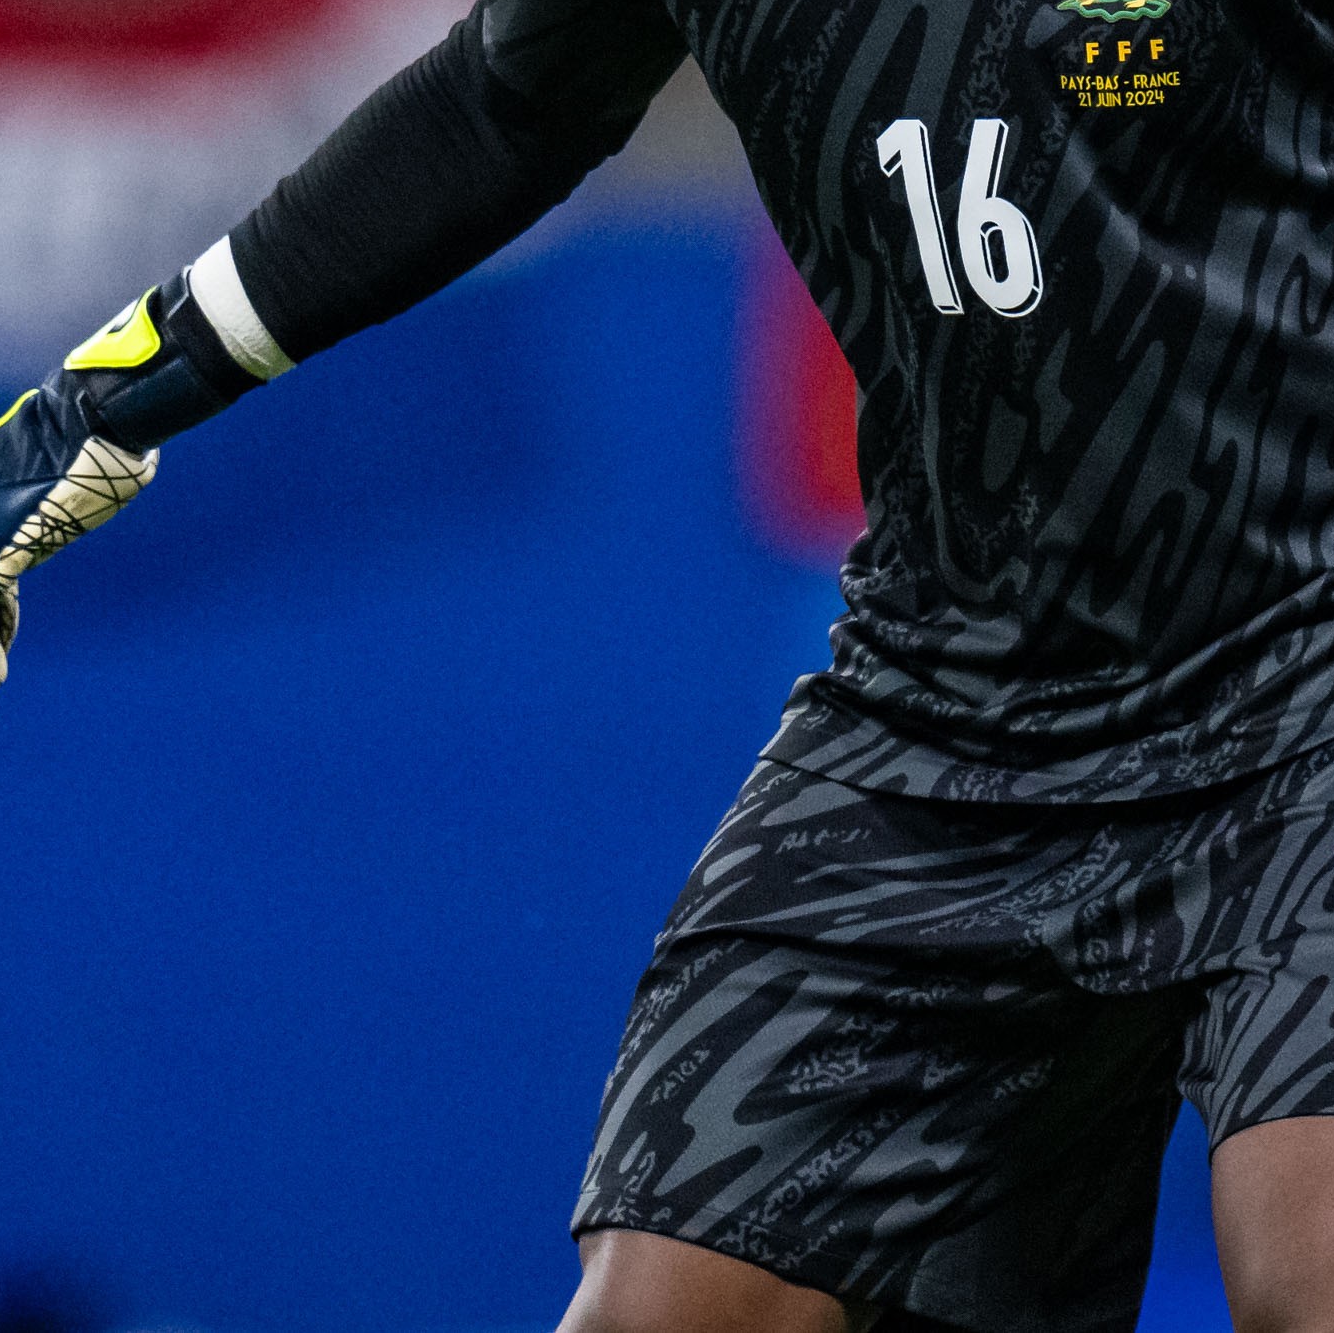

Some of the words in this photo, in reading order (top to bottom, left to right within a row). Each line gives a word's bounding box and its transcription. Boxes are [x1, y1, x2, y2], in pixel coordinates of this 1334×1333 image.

[1060, 75, 1119, 90] PAYS-BAS
[1133, 71, 1181, 89] FRANCE
[1078, 92, 1092, 107] 21
[1096, 92, 1122, 107] JUIN
[1125, 89, 1165, 106] 2024
[876, 118, 1044, 318] 16
